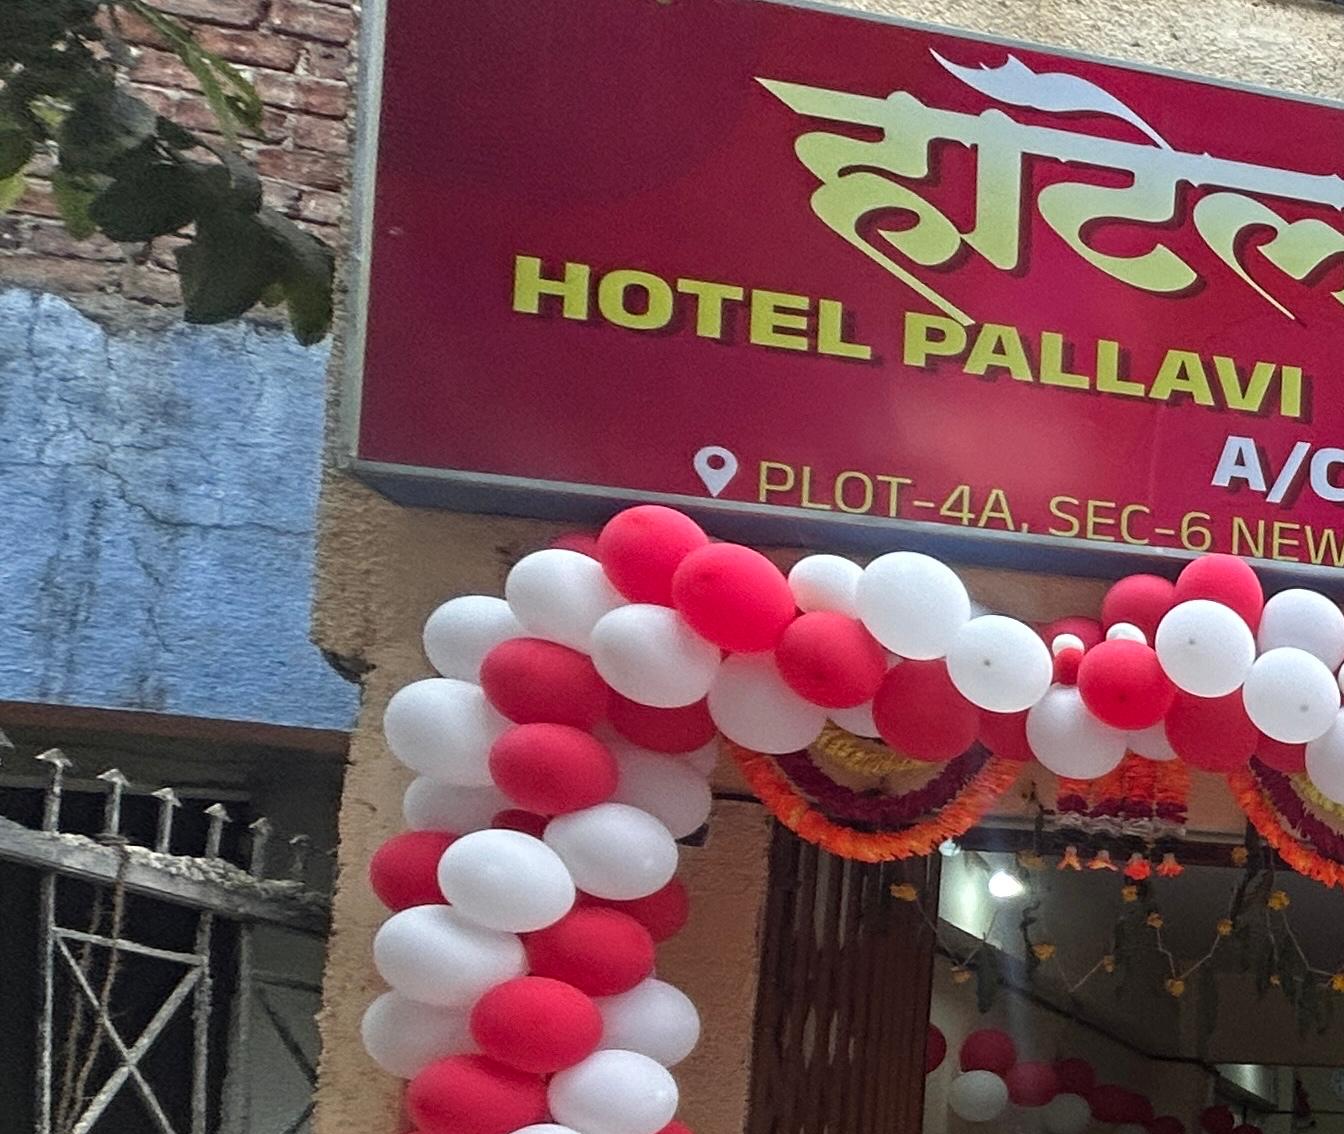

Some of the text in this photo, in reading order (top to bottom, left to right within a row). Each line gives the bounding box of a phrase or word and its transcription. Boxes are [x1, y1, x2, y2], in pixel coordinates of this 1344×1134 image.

[512, 255, 872, 361] HOTEL
[903, 315, 1302, 418] PALLAVI
[1048, 496, 1211, 551] SEC-6
